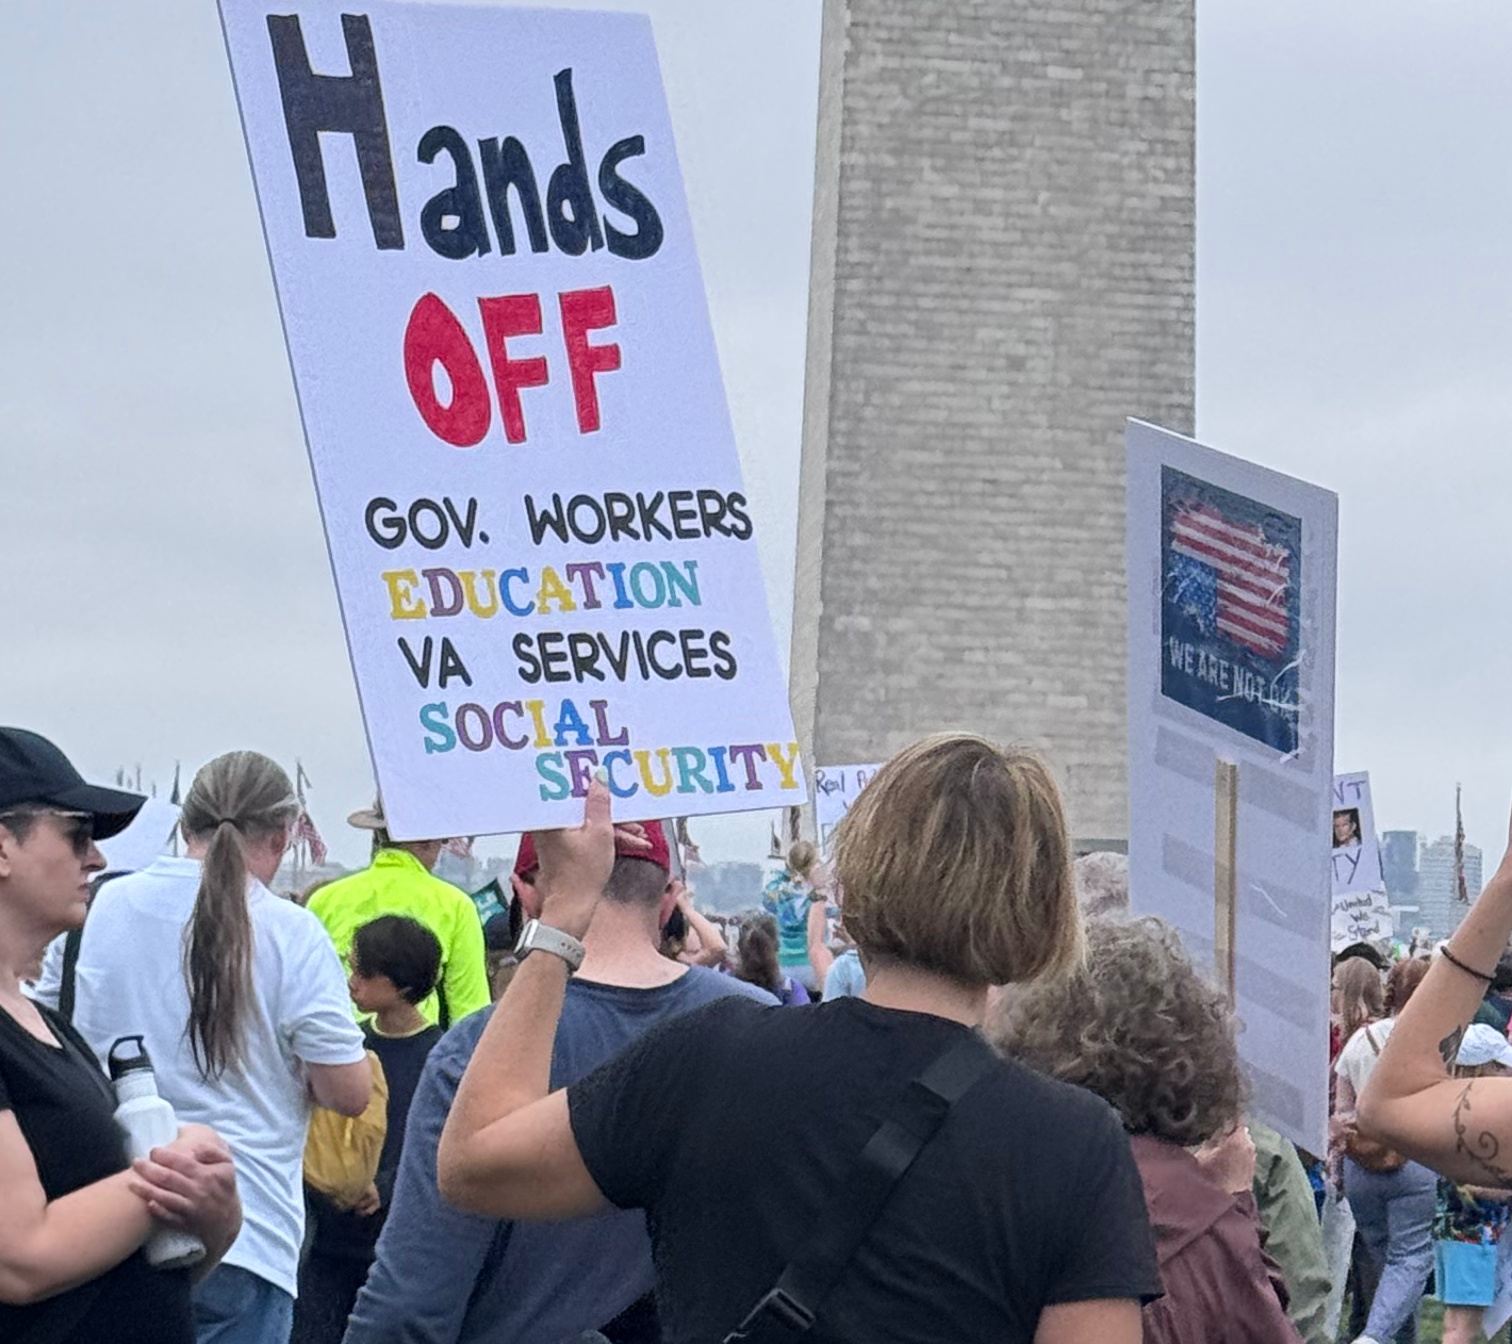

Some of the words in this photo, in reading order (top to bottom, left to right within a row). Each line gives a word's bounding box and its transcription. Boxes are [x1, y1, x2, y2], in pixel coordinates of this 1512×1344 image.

[265, 14, 664, 260] Hands
[404, 285, 621, 447] OFF
[365, 495, 489, 549] GOV.
[525, 490, 753, 545] WORKERS
[382, 560, 701, 620] EDUCATION
[398, 634, 471, 689] VA
[518, 629, 737, 684] SERVICES
[1169, 635, 1195, 676] WE
[1197, 648, 1229, 691] ARE
[1233, 664, 1265, 705] NOT
[419, 699, 628, 753] SOCIAL
[539, 741, 800, 803] SECURITY
